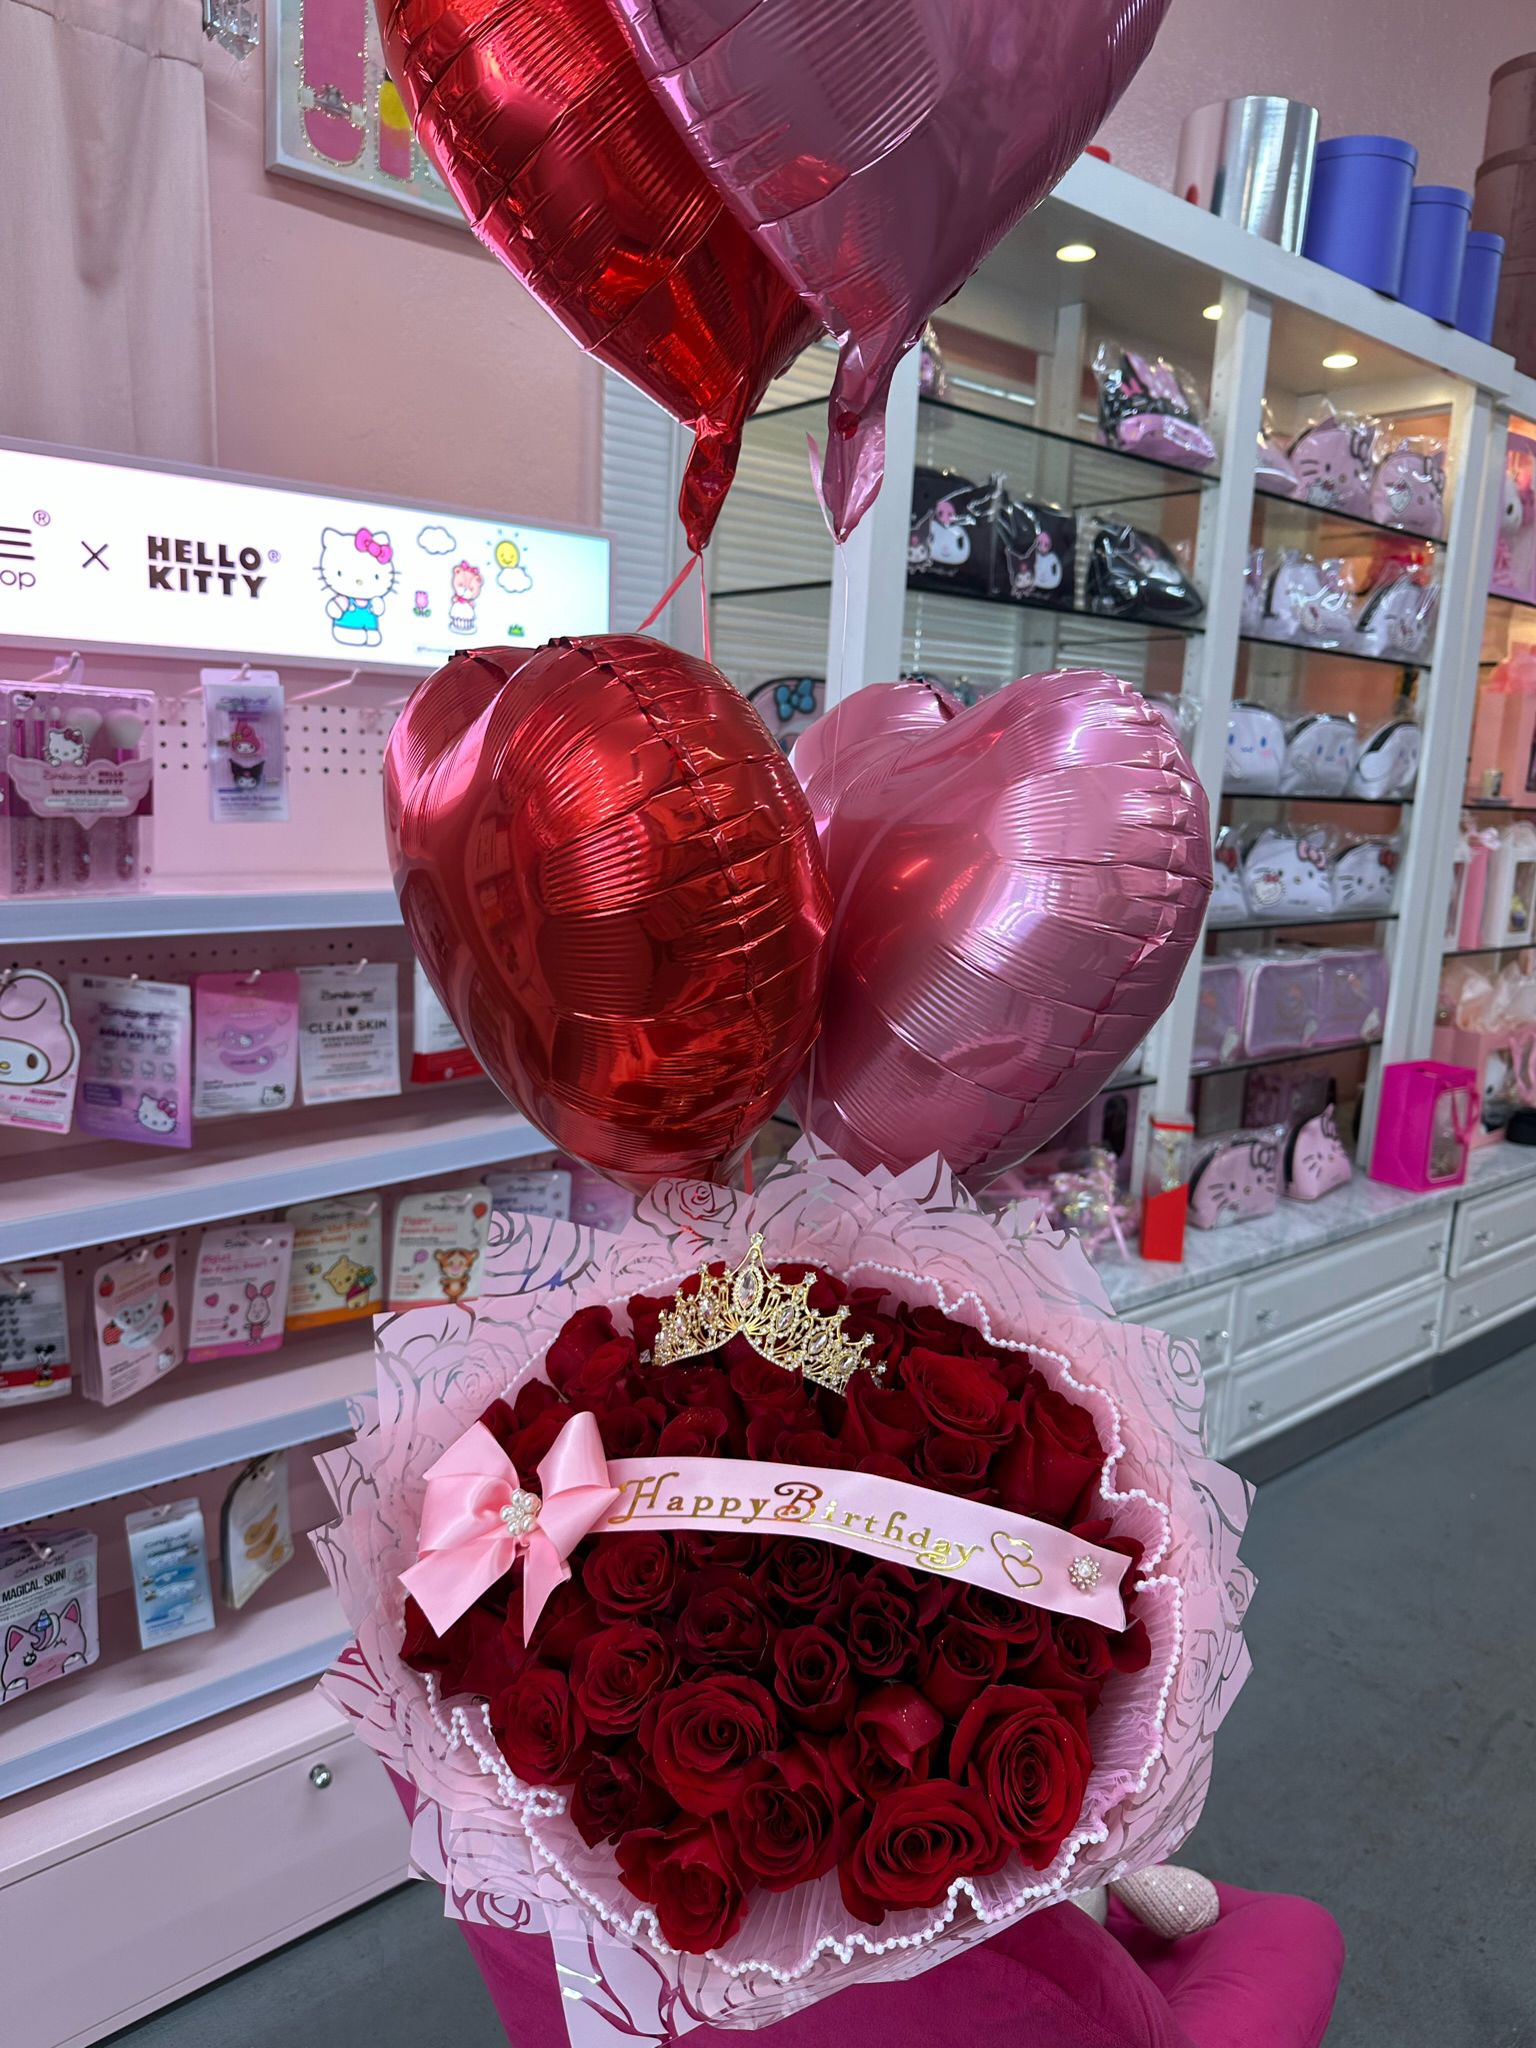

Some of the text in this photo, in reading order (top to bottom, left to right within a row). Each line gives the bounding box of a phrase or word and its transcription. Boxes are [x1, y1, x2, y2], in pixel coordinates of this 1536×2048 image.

[148, 564, 267, 599] KITTY
[336, 1006, 342, 1017] I
[308, 1018, 388, 1035] CLEAR SKIN
[608, 1471, 984, 1571] Happy Birthday
